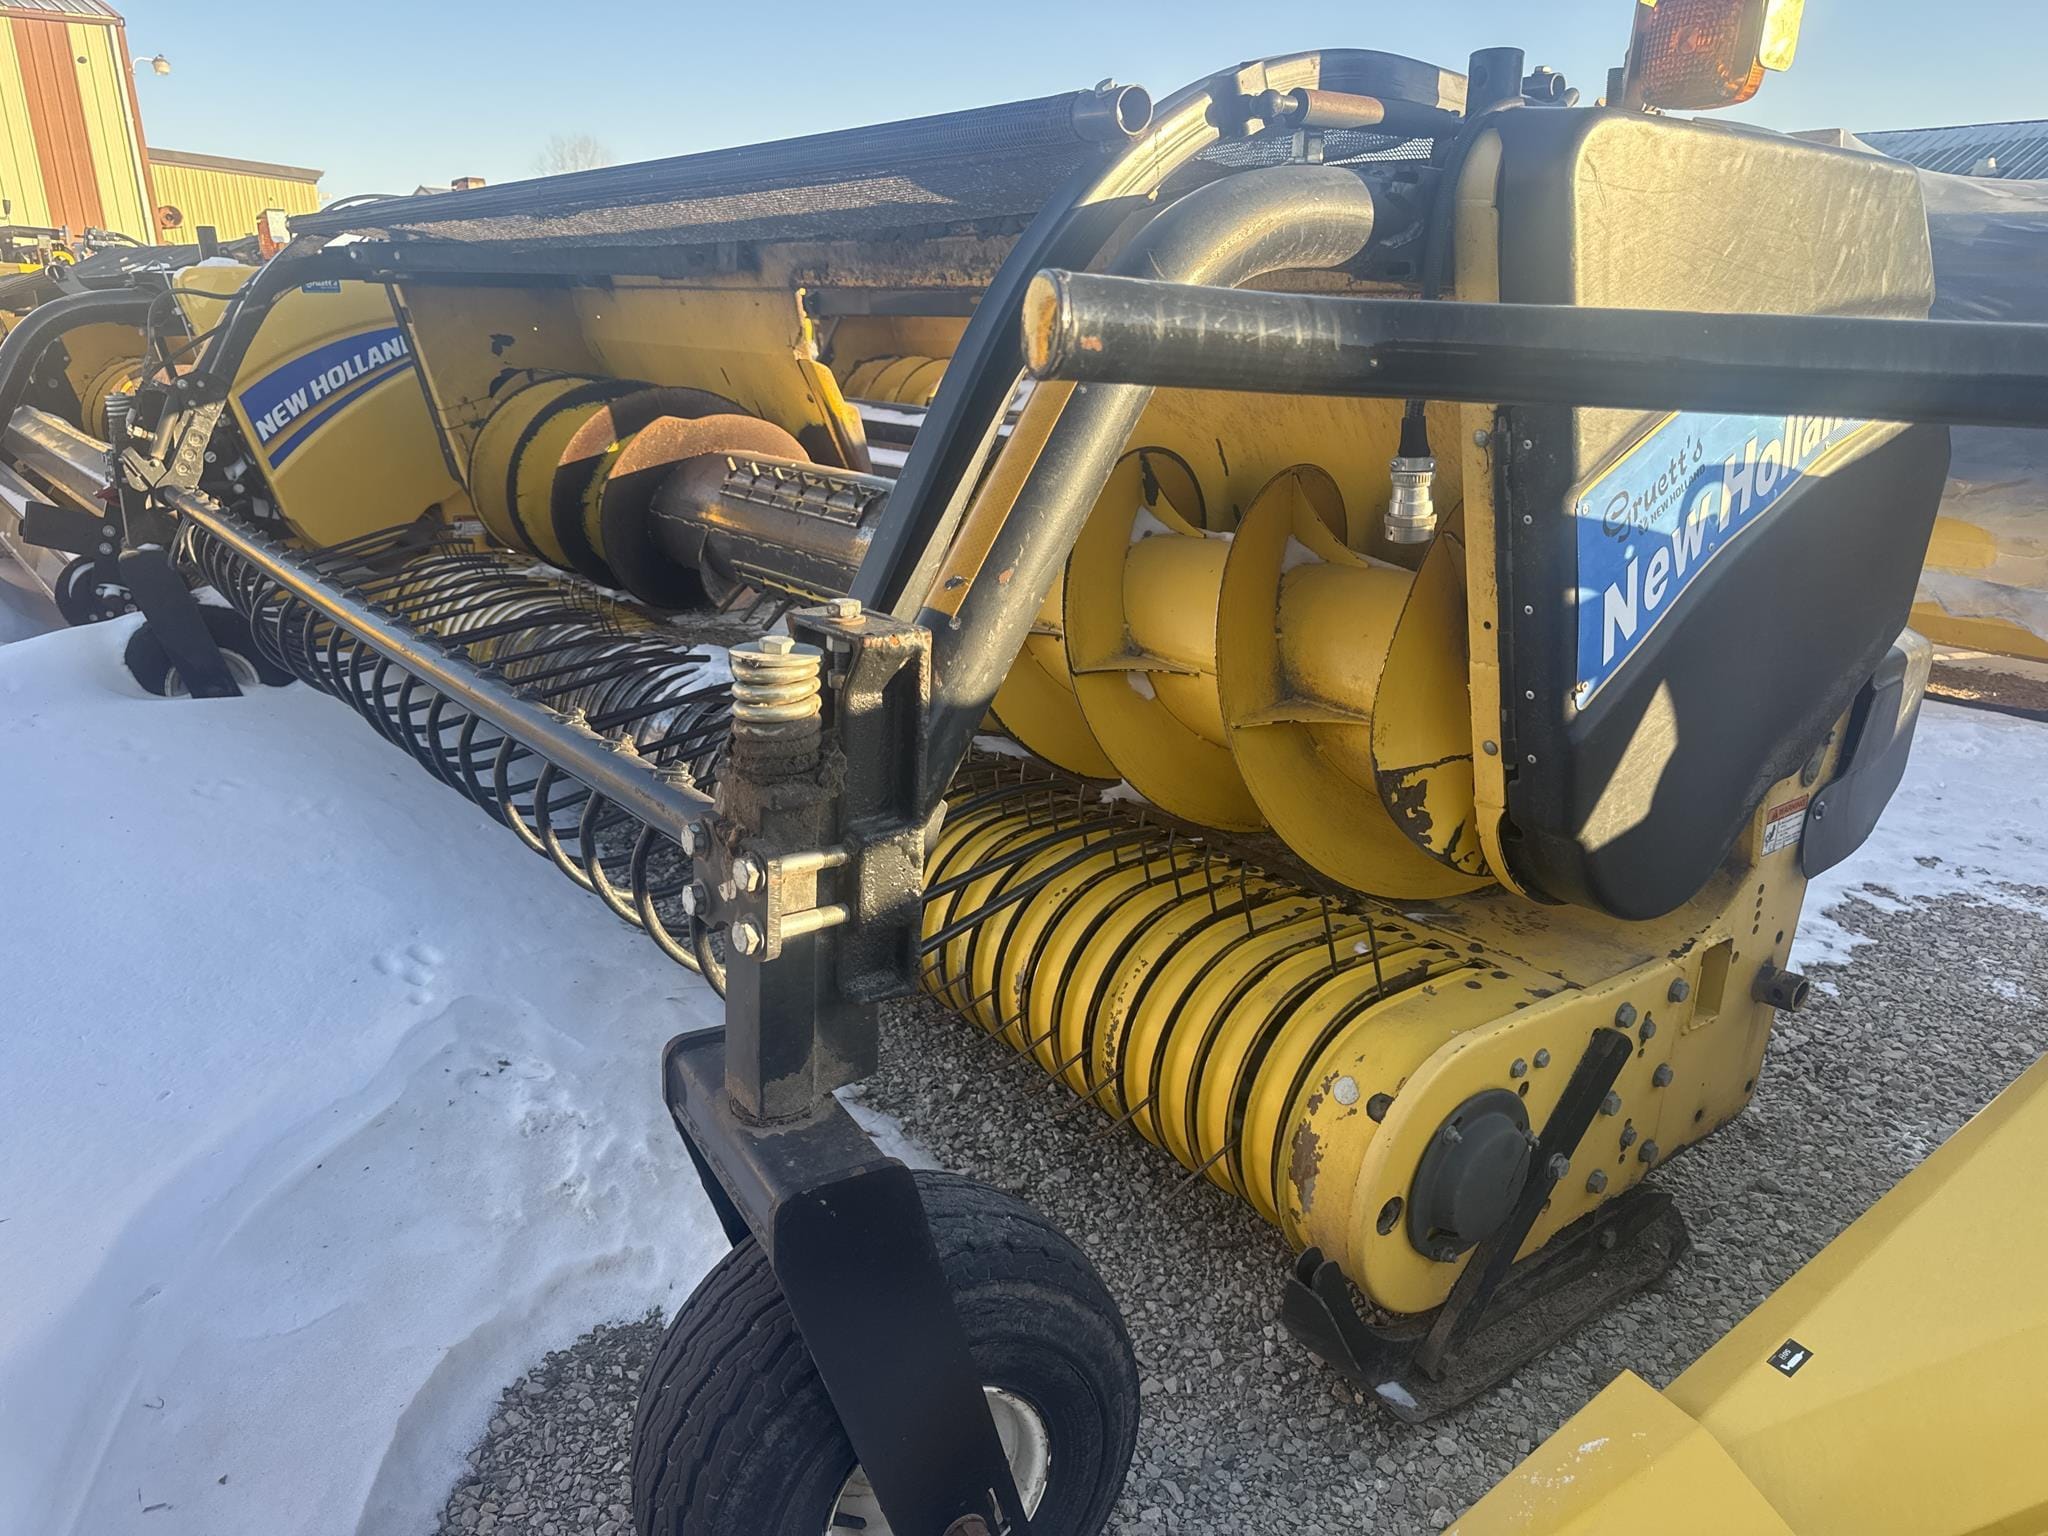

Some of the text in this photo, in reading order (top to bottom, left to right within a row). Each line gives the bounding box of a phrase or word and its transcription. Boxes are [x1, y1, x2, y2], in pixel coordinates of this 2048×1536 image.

[255, 335, 409, 441] NEW HOLLAN
[1602, 434, 1703, 543] Gruett's
[1650, 463, 1705, 525] NEW HOLLAND
[1602, 491, 1711, 667] New
